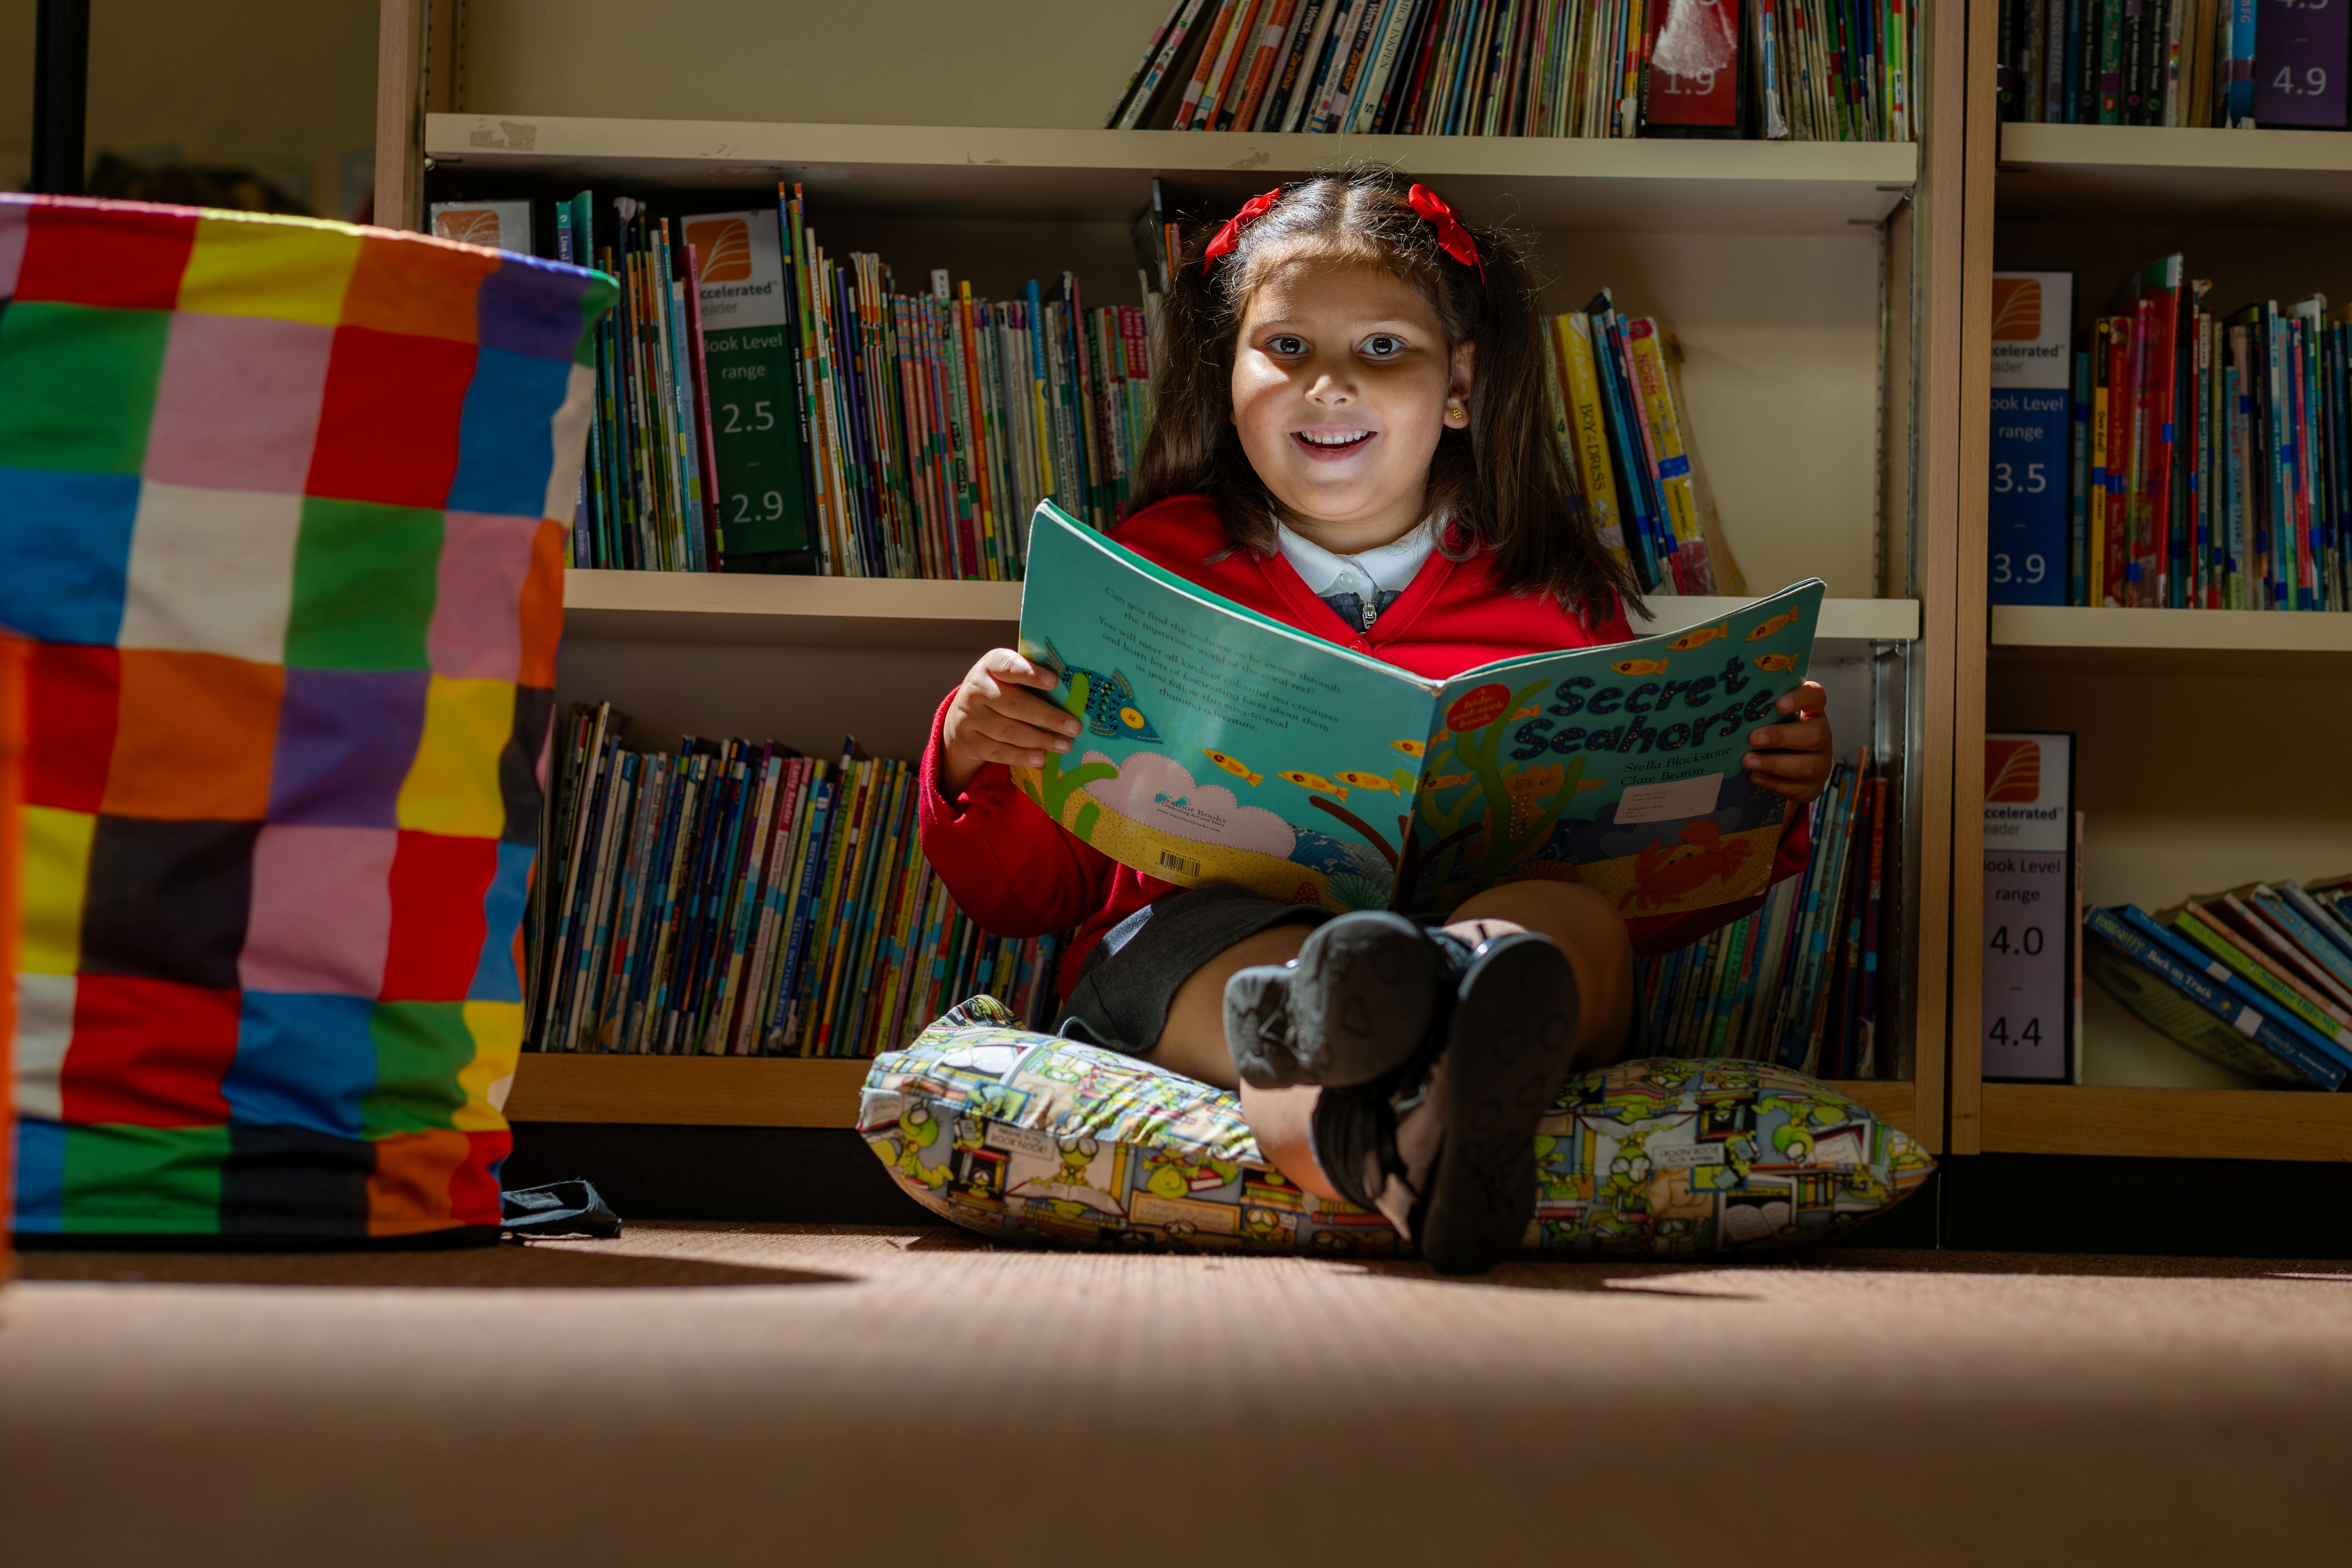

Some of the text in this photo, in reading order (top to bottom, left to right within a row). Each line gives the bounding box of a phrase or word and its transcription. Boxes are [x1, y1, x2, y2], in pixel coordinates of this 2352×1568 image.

[1300, 4, 1319, 35] Wreck
[1360, 1, 1379, 33] Wreck
[1379, 27, 1401, 69] INKPEN
[1280, 51, 1303, 93] Zanzibar
[1341, 49, 1363, 90] Zanzibar
[1664, 66, 1716, 96] 1.9
[2272, 65, 2327, 96] 4.9
[701, 284, 772, 299] ccelerated
[701, 302, 738, 316] eader
[742, 332, 782, 350] Level
[1993, 344, 2058, 358] celerated
[721, 364, 766, 381] range
[794, 361, 803, 383] Simple
[1635, 352, 1657, 397] NORM
[797, 385, 806, 410] Science
[1991, 394, 2064, 412] ook Level
[722, 400, 775, 434] 2.5
[800, 413, 806, 421] of
[1579, 403, 1607, 492] BOY DRESS
[1998, 426, 2044, 443] range
[1993, 463, 2047, 494] 3.5
[731, 490, 784, 524] 2.9
[1992, 553, 2046, 584] 3.9
[1105, 587, 1125, 604] Can
[1128, 603, 1145, 615] you
[1148, 611, 1168, 626] find
[1171, 622, 1187, 635] the
[1190, 632, 1231, 653] seahorse
[1250, 653, 1261, 664] he
[1265, 661, 1296, 677] swims
[1299, 673, 1340, 693] through
[1124, 612, 1140, 625] the
[1143, 622, 1194, 650] mysterious
[1198, 648, 1225, 664] world
[1242, 665, 1258, 675] the
[1262, 673, 1288, 686] coral
[1292, 683, 1316, 695] reef?
[1099, 615, 1116, 632] You
[1119, 629, 1136, 642] will
[1139, 641, 1162, 655] meet
[1165, 653, 1178, 663] all
[1181, 658, 1208, 675] kinds
[1223, 678, 1269, 699] colourful
[1272, 695, 1289, 706] sea
[1292, 702, 1339, 723] creatures
[1102, 633, 1120, 647] and
[1123, 642, 1147, 661] learn
[1151, 657, 1167, 671] lots
[1183, 672, 1239, 702] fascinating
[1242, 696, 1267, 709] facts
[1269, 706, 1299, 721] about
[1302, 717, 1329, 732] them
[1136, 664, 1289, 729] as you follow this easy-to-read
[1476, 688, 1486, 697] A
[1548, 655, 1749, 716] Secret
[1159, 687, 1258, 731] rhyming adventure.
[1450, 701, 1503, 722] and-seek
[1464, 696, 1495, 709] hide-
[1459, 713, 1490, 728] book
[1509, 689, 1775, 760] Seahorse
[1624, 747, 1731, 773] Stella Blackstone
[786, 762, 802, 790] Early
[1621, 768, 1704, 786] Clare Beaton
[780, 790, 797, 825] Reader
[1155, 793, 1227, 824] Barefoot Books
[1157, 808, 1220, 833] www.barefootbooks.com
[1161, 802, 1190, 817] Celebrating
[1984, 806, 2057, 820] ccelerated
[1871, 785, 1887, 874] Roald Dahl
[1984, 822, 2021, 836] eader
[770, 834, 787, 887] Francesca Simo
[798, 839, 818, 896] JUDITH KERR
[2020, 858, 2060, 874] Level
[1995, 888, 2041, 905] range
[1990, 926, 2045, 956] 4.0
[773, 915, 804, 1023] TIGER WHO CAME TO TEA
[2145, 947, 2215, 1001] Back on Track
[1795, 962, 1815, 1028] Lucy Daniels
[2258, 969, 2299, 1002] Sophie
[1989, 1016, 2043, 1047] 4.4
